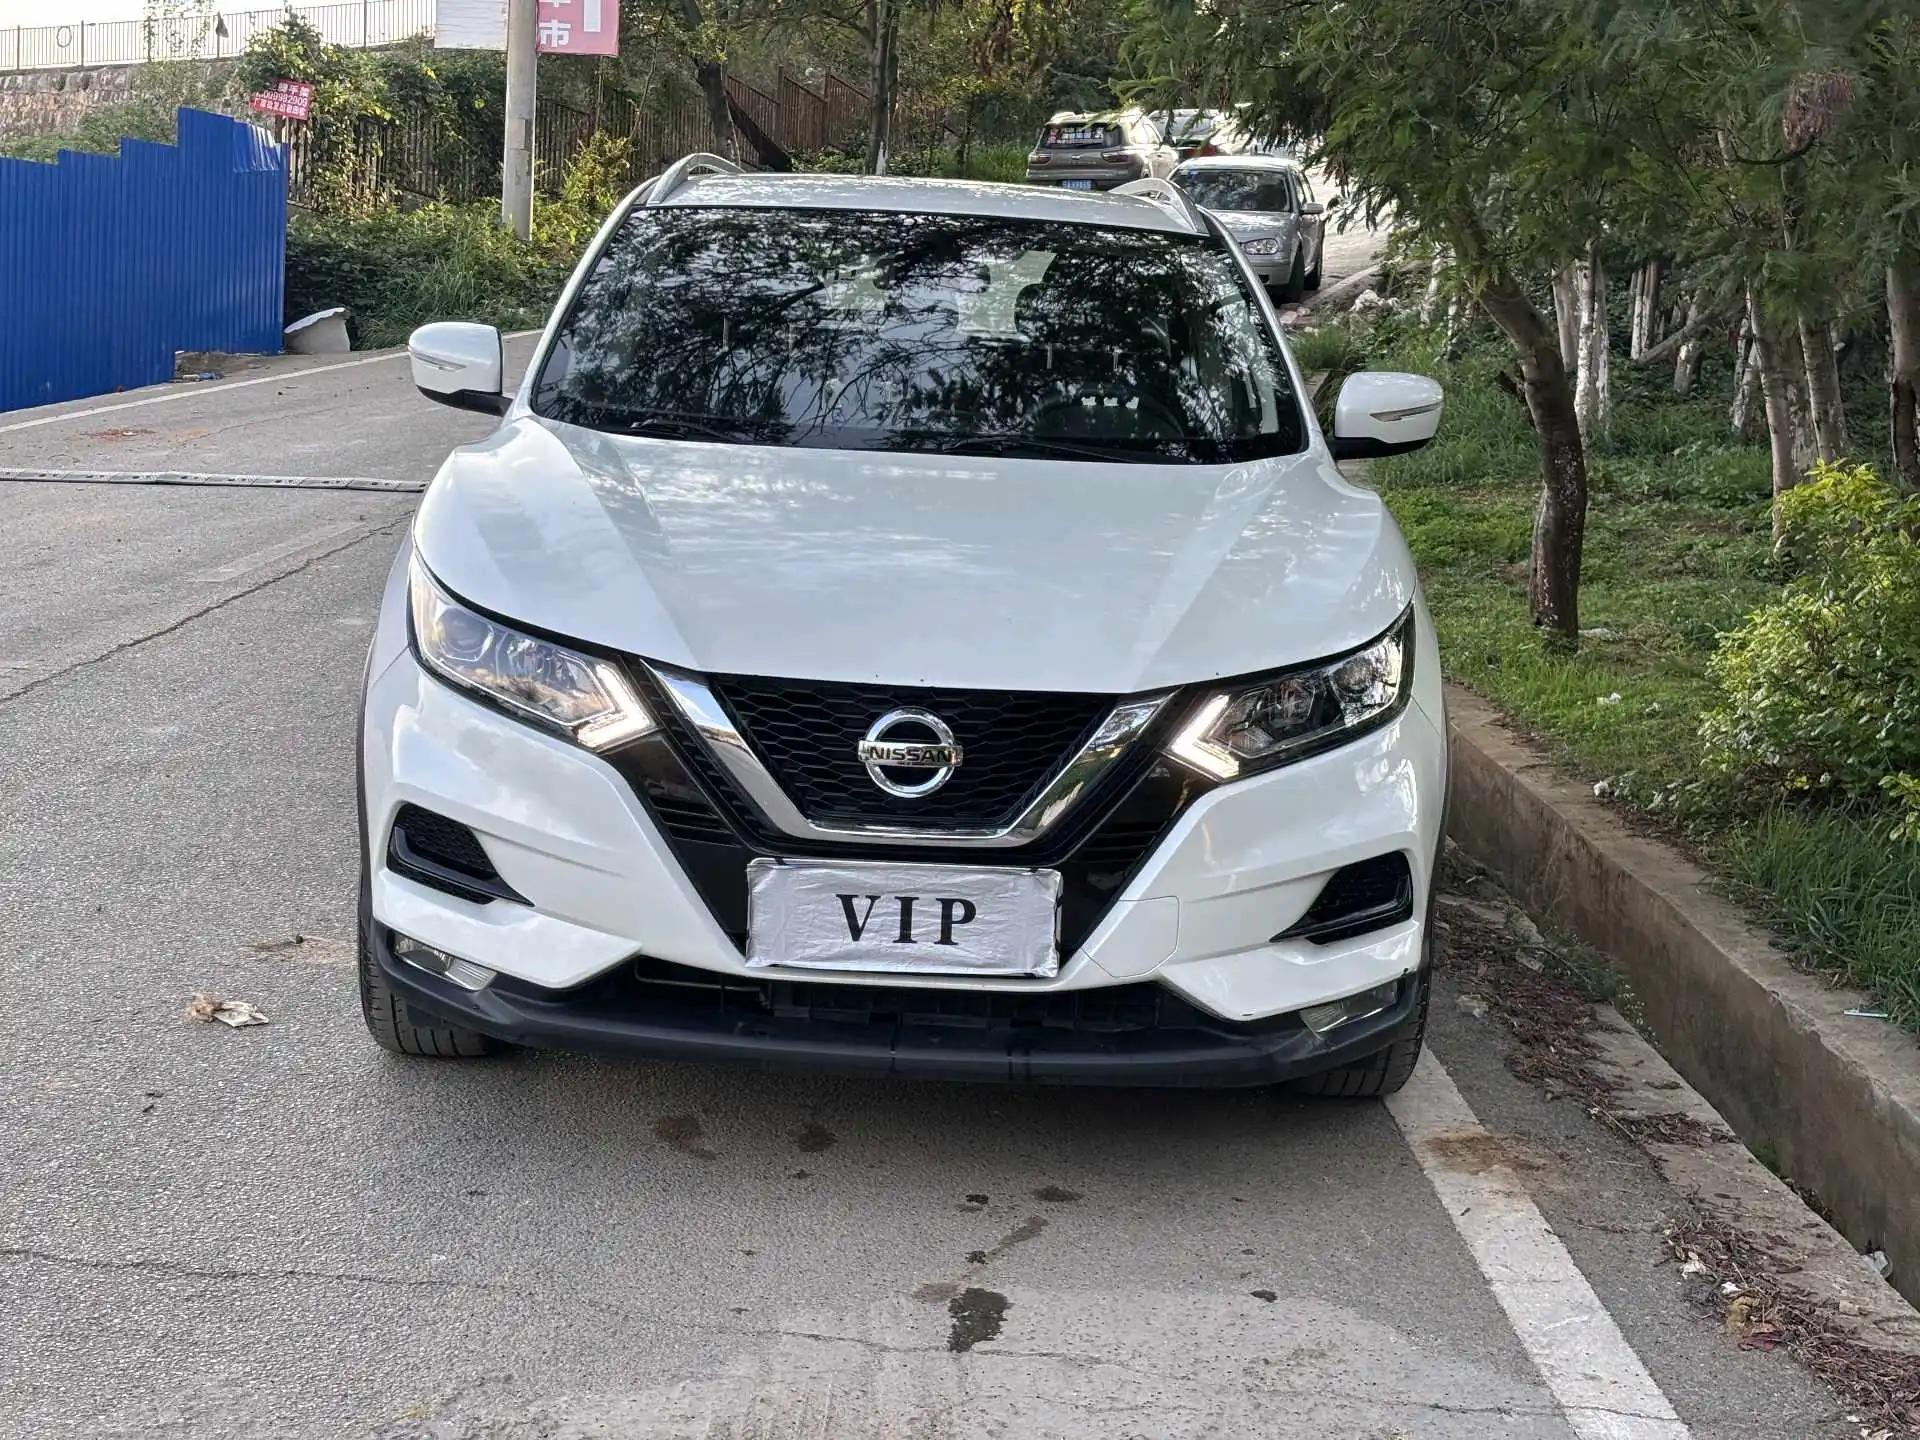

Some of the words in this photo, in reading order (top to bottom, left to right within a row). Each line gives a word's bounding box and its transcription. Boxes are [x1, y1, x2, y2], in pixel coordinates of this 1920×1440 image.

[539, 0, 571, 48] 市
[869, 745, 953, 763] NISSAN
[835, 893, 977, 946] VIP
